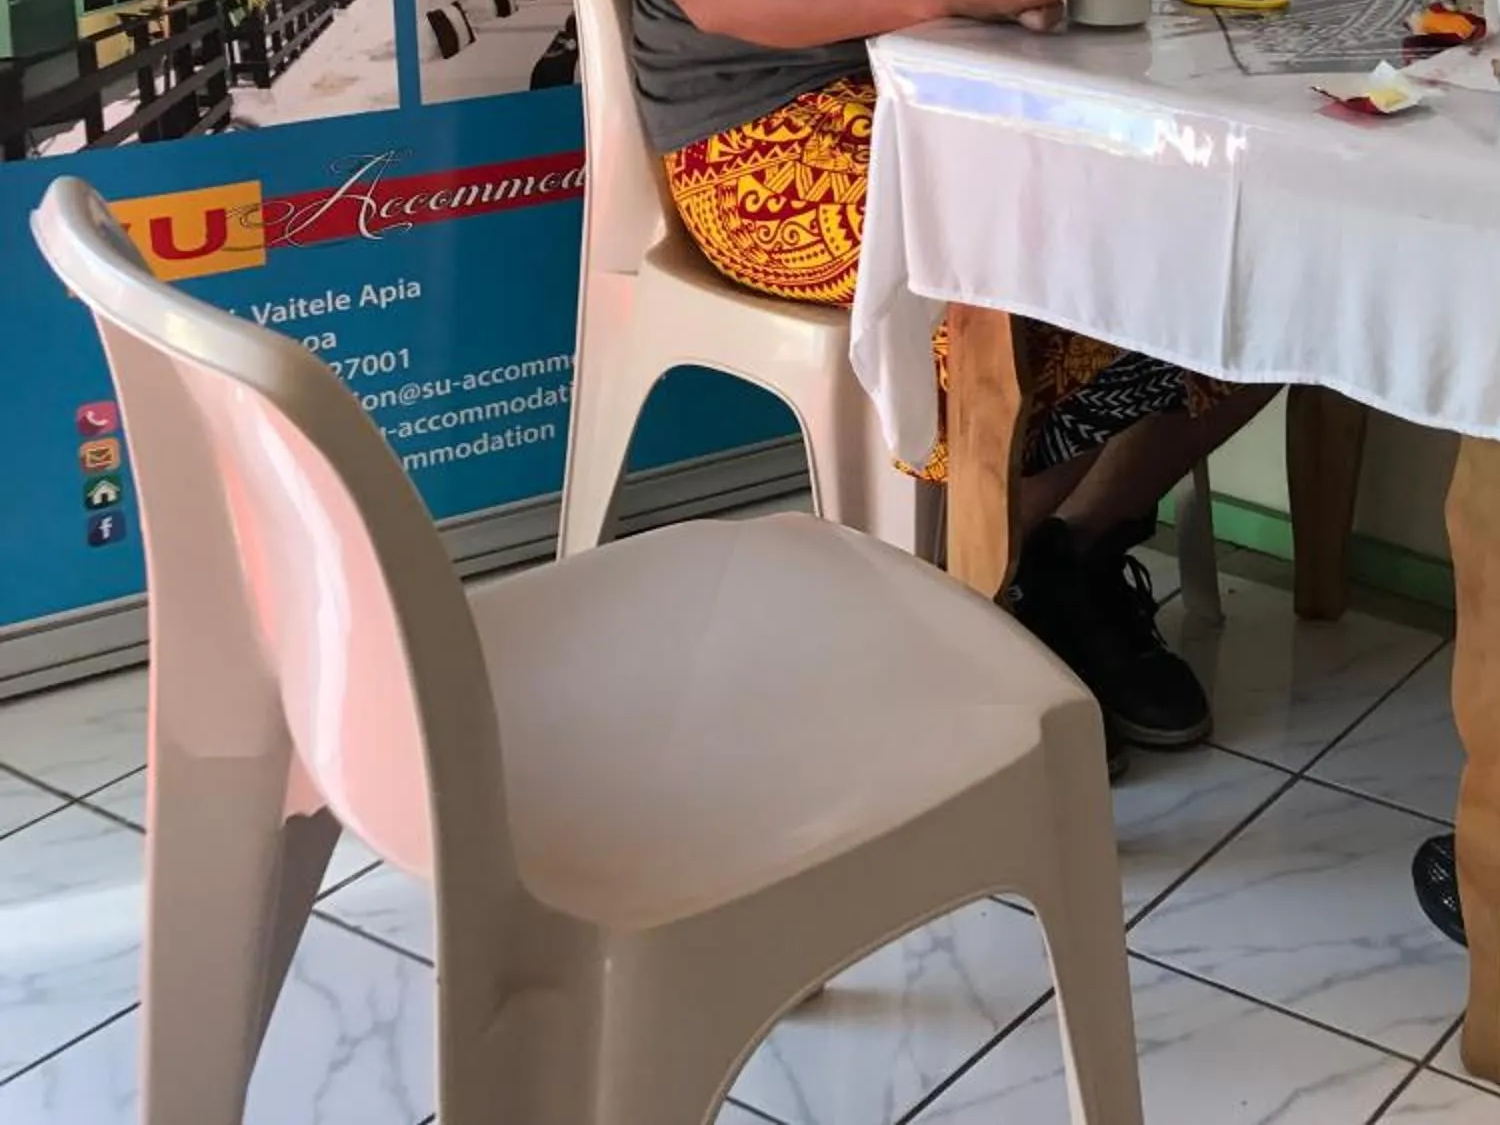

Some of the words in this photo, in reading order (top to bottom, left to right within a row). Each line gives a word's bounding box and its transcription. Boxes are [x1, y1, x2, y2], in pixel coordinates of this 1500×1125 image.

[121, 208, 227, 260] U
[251, 290, 351, 325] Vaitele
[359, 278, 422, 308] Apia
